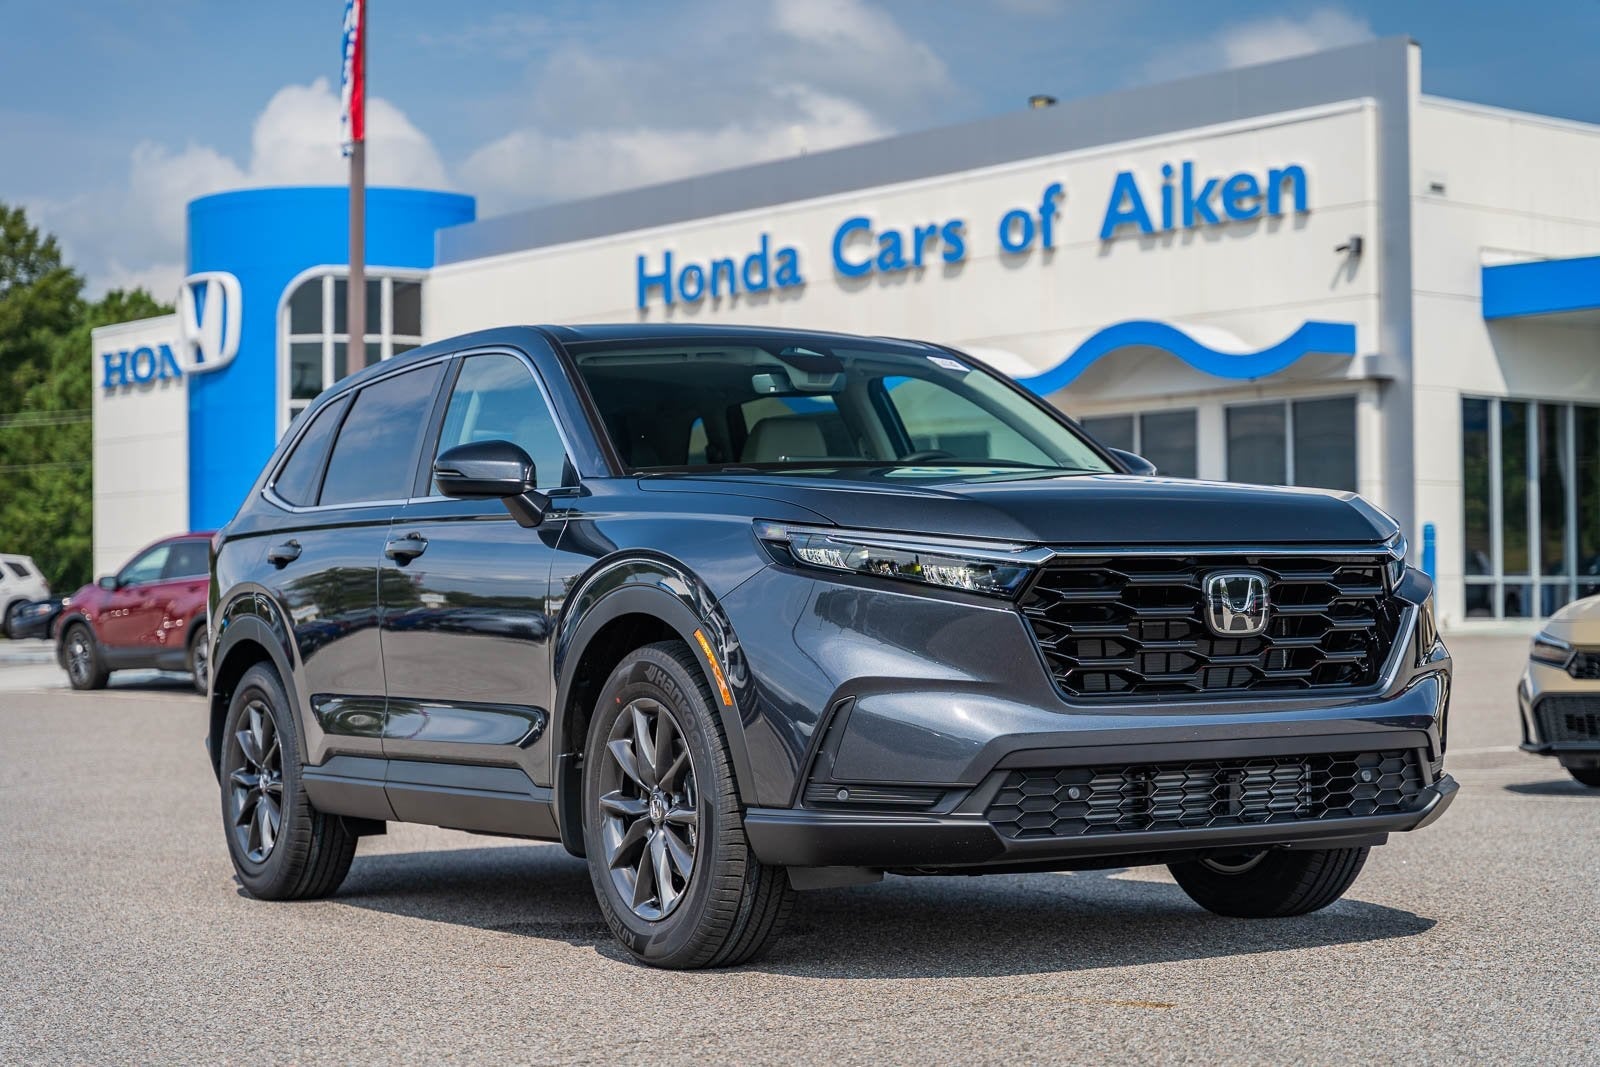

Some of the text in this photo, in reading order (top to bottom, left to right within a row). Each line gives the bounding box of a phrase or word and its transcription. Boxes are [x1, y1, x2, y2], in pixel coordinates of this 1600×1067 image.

[637, 160, 1308, 309] Honda Cars of Aiken
[101, 341, 182, 389] HON
[654, 668, 706, 765] Hankoo
[597, 890, 636, 949] KINER
